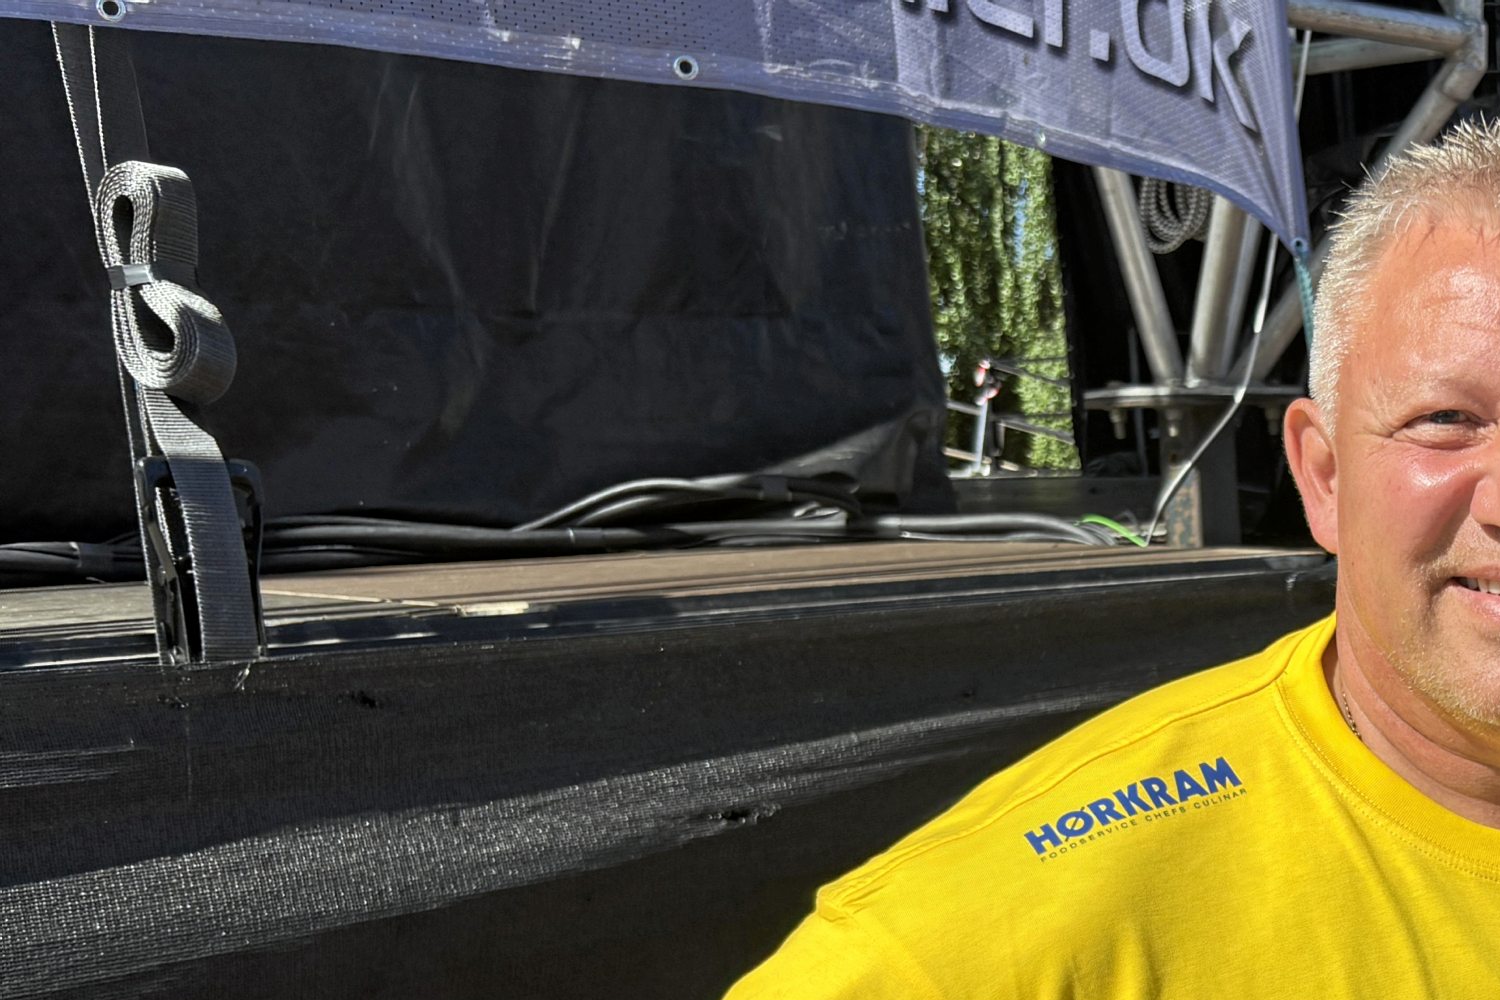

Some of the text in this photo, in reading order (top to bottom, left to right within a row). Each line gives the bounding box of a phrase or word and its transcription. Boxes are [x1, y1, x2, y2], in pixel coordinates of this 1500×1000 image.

[1023, 756, 1243, 856] HØRKRAM
[1040, 819, 1138, 863] FOODSERVICE
[1145, 806, 1187, 822] CHEFS
